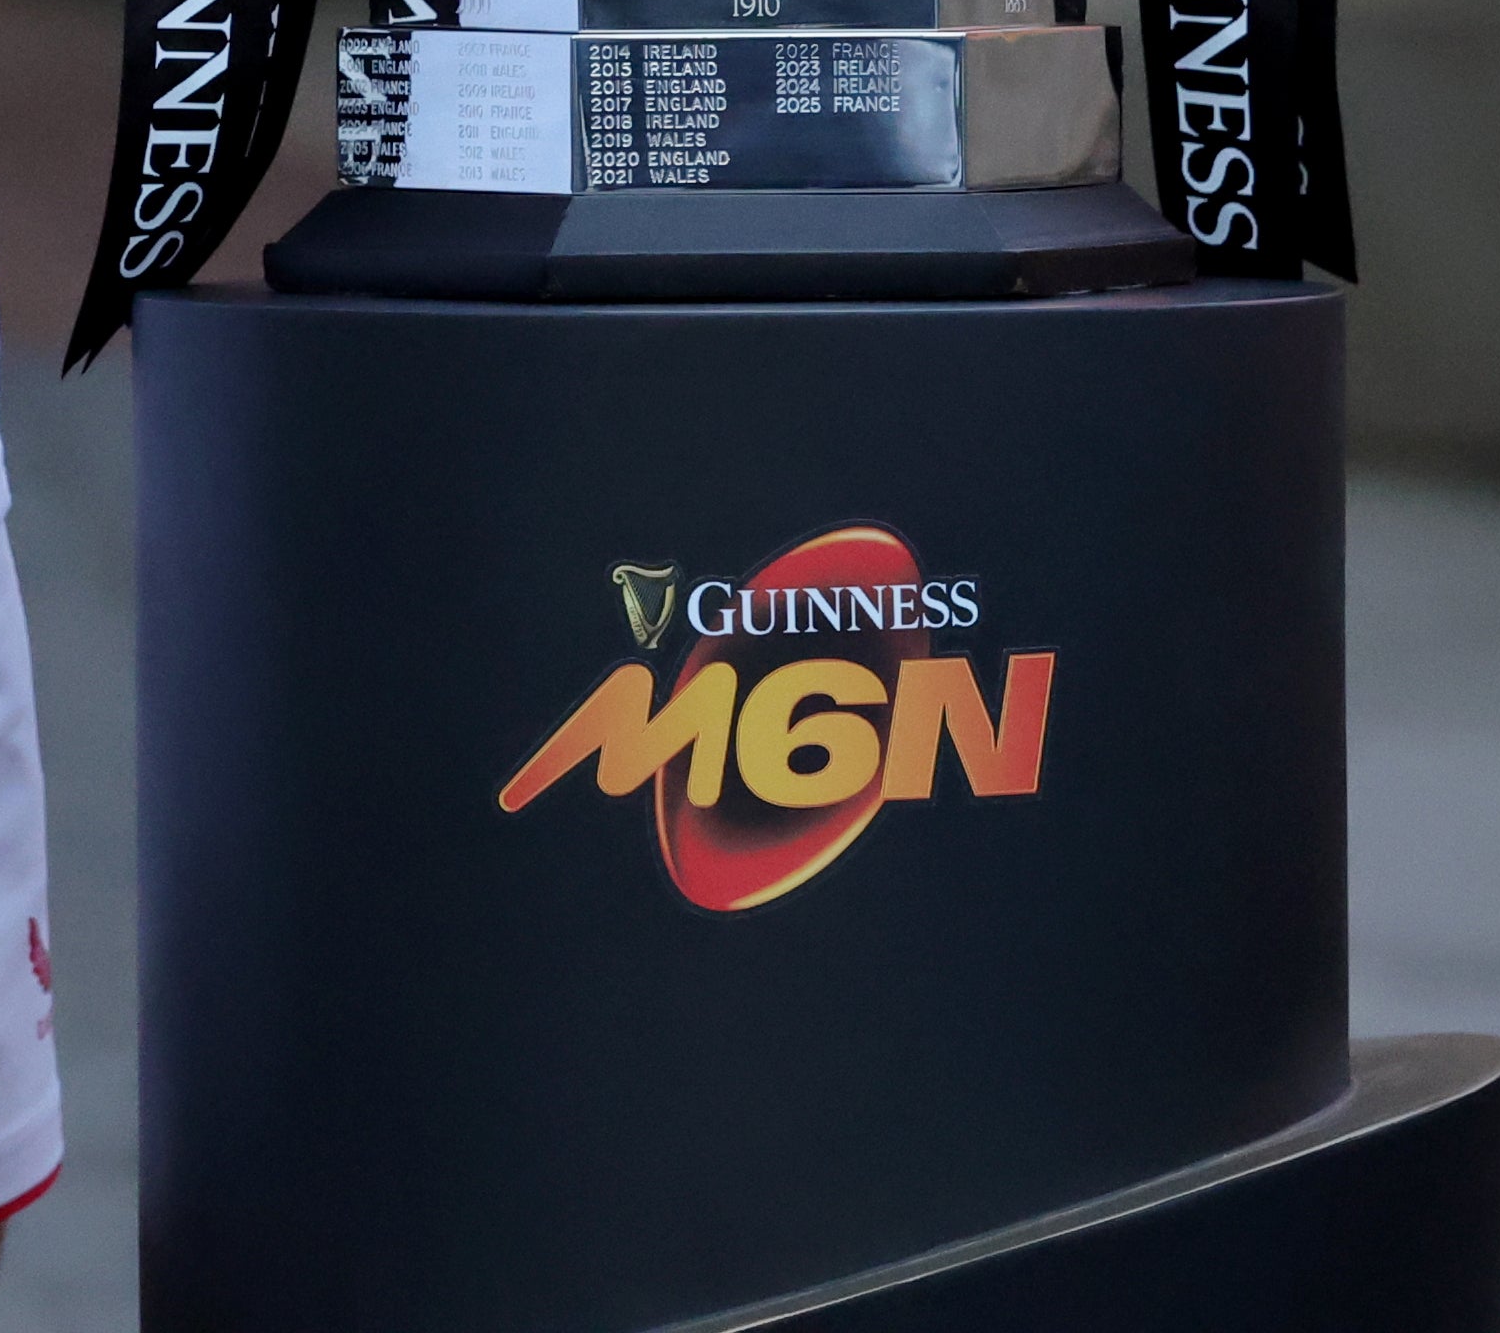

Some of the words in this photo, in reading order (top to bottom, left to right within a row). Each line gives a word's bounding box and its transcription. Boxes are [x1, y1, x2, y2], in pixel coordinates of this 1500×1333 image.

[589, 45, 630, 60] 2014
[643, 44, 717, 60] IRELAND
[775, 43, 820, 60] 2022
[832, 42, 900, 59] FRANCE
[371, 60, 420, 74] ENGLAND
[589, 62, 632, 77] 2015
[643, 61, 718, 76] IRELAND
[775, 61, 821, 77] 2023
[833, 60, 900, 76] IRELAND
[590, 80, 633, 95] 2016
[645, 79, 726, 94] ENGLAND
[775, 78, 821, 95] 2024
[833, 77, 902, 94] IRELAND
[371, 102, 420, 115] ENGLAND
[490, 105, 532, 120] FRANCE
[590, 97, 632, 112] 2017
[645, 97, 727, 112] ENGLAND
[776, 97, 821, 113] 2025
[833, 96, 900, 113] FRANCE
[590, 115, 633, 130] 2018
[646, 114, 720, 129] IRELAND
[591, 133, 633, 148] 2019
[646, 132, 707, 148] WALES
[371, 142, 407, 157] WALES
[591, 152, 640, 167] 2020
[648, 151, 730, 166] ENGLAND
[591, 169, 633, 184] 2021
[650, 169, 710, 184] WALES
[687, 581, 980, 637] GUINNESS
[499, 651, 1056, 814] M6N
